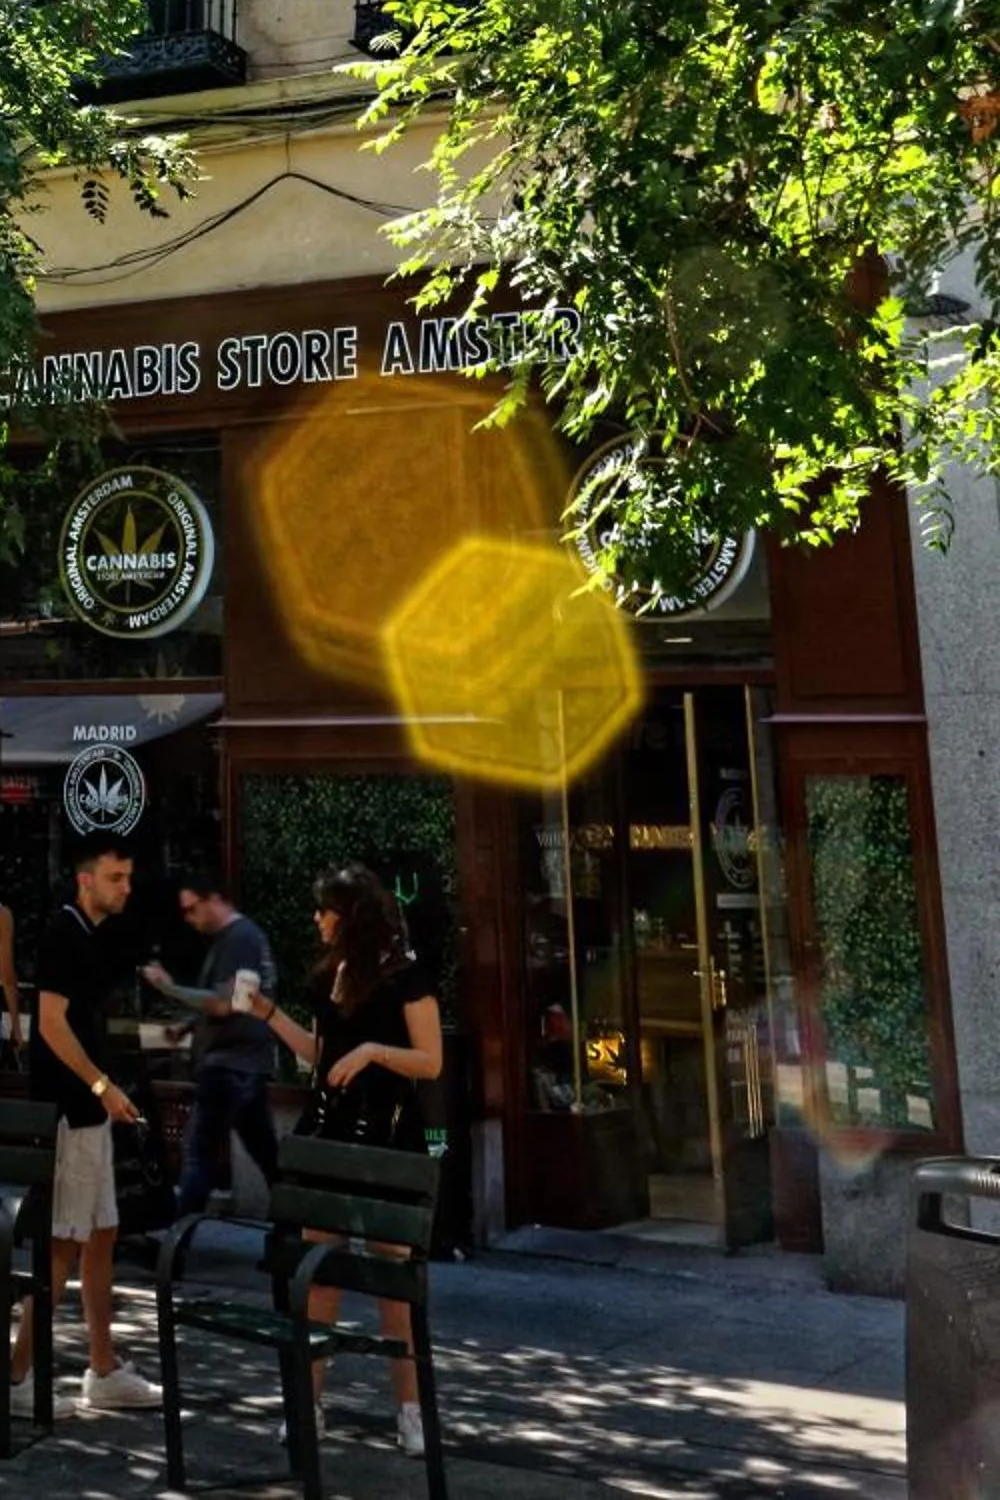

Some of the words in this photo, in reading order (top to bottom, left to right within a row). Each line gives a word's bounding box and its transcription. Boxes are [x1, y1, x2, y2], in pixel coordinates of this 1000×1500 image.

[217, 327, 358, 390] STORE
[379, 307, 582, 376] AMSTER
[69, 474, 134, 542] AMSTERDAM
[166, 491, 198, 557] ORIGINAL
[66, 546, 96, 610] ORIGINAL
[85, 551, 177, 572] CANNABIS
[128, 560, 196, 629] AMSTERDAM
[72, 724, 137, 741] MADRID
